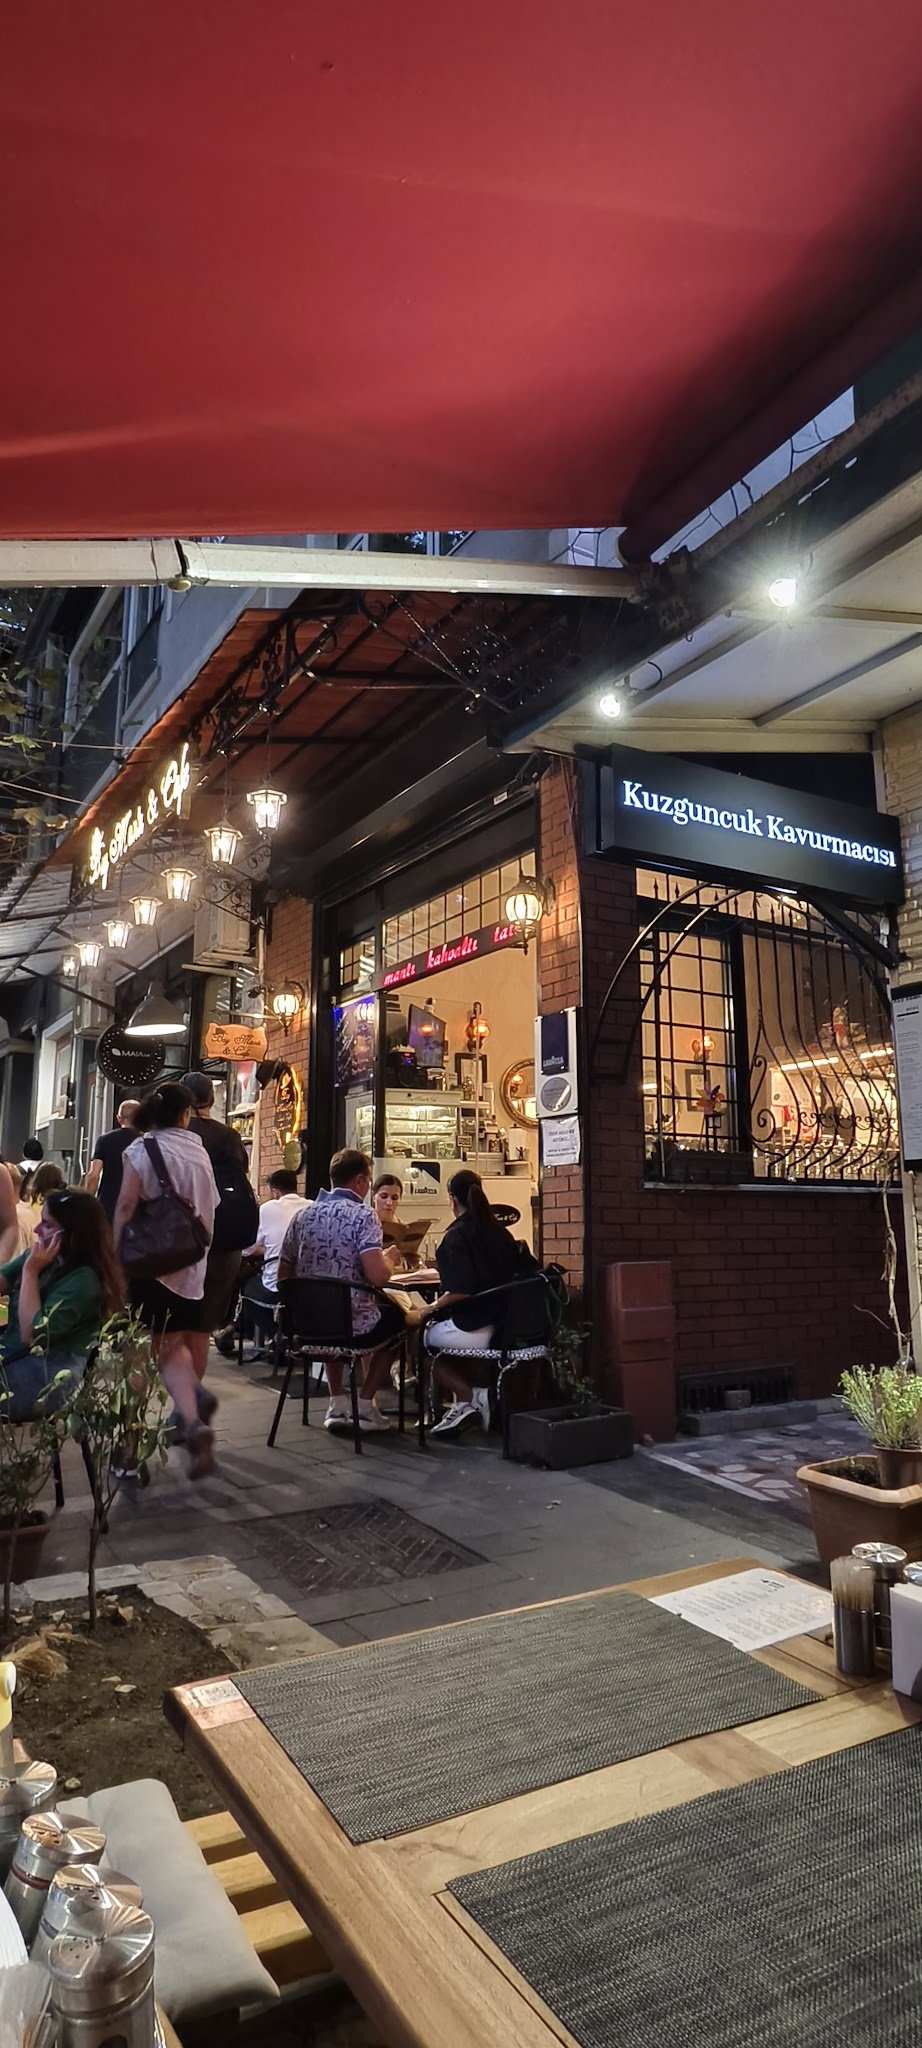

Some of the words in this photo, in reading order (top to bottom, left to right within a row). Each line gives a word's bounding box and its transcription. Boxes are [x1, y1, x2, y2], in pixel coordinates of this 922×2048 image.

[147, 789, 159, 825] &
[622, 780, 764, 837] Kuzguncuk
[766, 815, 897, 867] Kavurmacısı
[427, 936, 479, 969] kahvaltı
[222, 1046, 231, 1055] &
